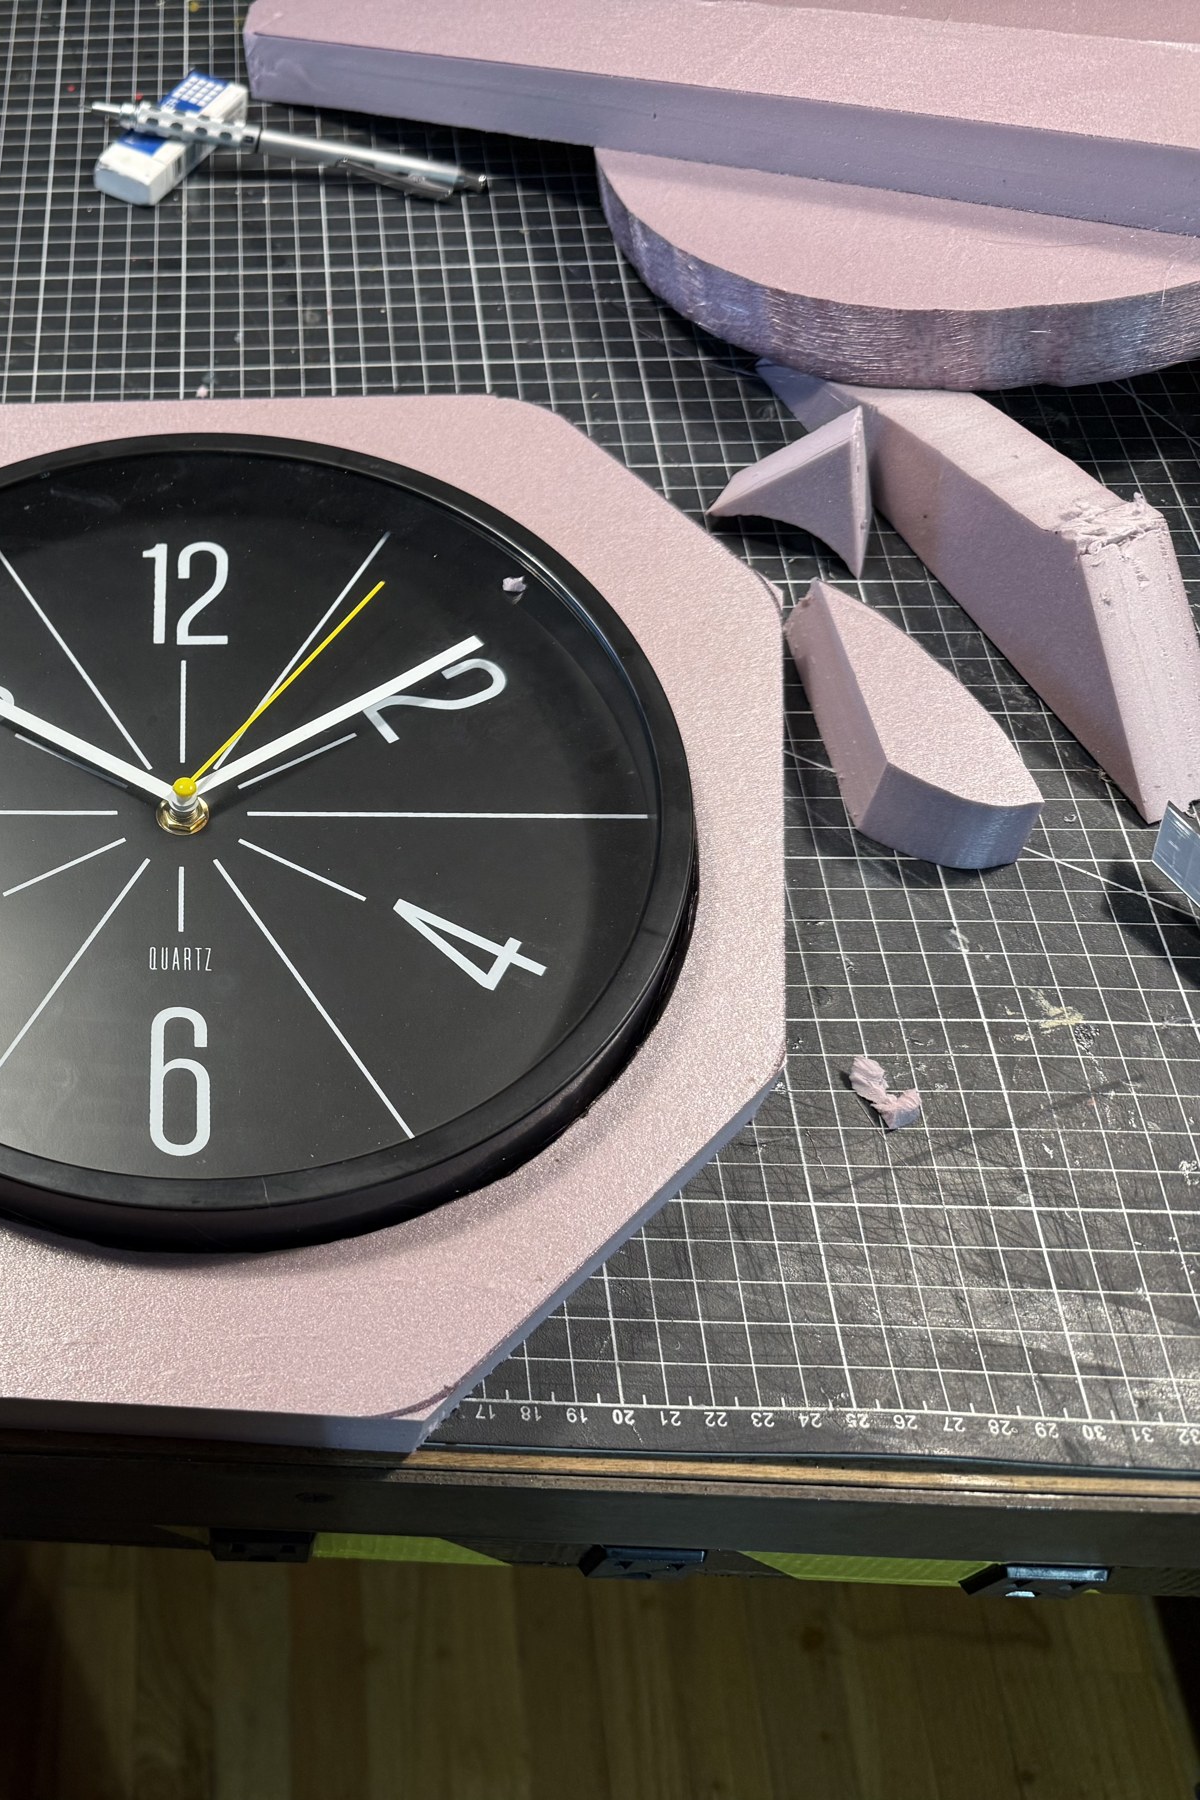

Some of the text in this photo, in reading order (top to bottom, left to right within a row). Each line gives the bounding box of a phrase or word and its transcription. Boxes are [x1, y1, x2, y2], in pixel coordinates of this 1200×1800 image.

[142, 541, 231, 647] 12
[360, 657, 509, 744] 2
[393, 898, 548, 992] 4
[149, 946, 213, 972] QUARTZ
[149, 1006, 212, 1157] 6
[475, 1404, 496, 1420] 17
[520, 1405, 542, 1421] 18
[566, 1407, 588, 1424] 19
[612, 1408, 636, 1425] 20
[660, 1410, 682, 1426] 21
[703, 1411, 728, 1427] 22
[751, 1412, 775, 1428] 23
[798, 1412, 822, 1428] 24
[845, 1413, 870, 1428] 25
[893, 1414, 918, 1430] 26
[943, 1416, 966, 1432] 27
[987, 1419, 1012, 1435] 28
[1034, 1422, 1059, 1439] 29
[1082, 1424, 1107, 1441] 30
[1131, 1427, 1154, 1443] 31
[1176, 1428, 1200, 1445] 32
